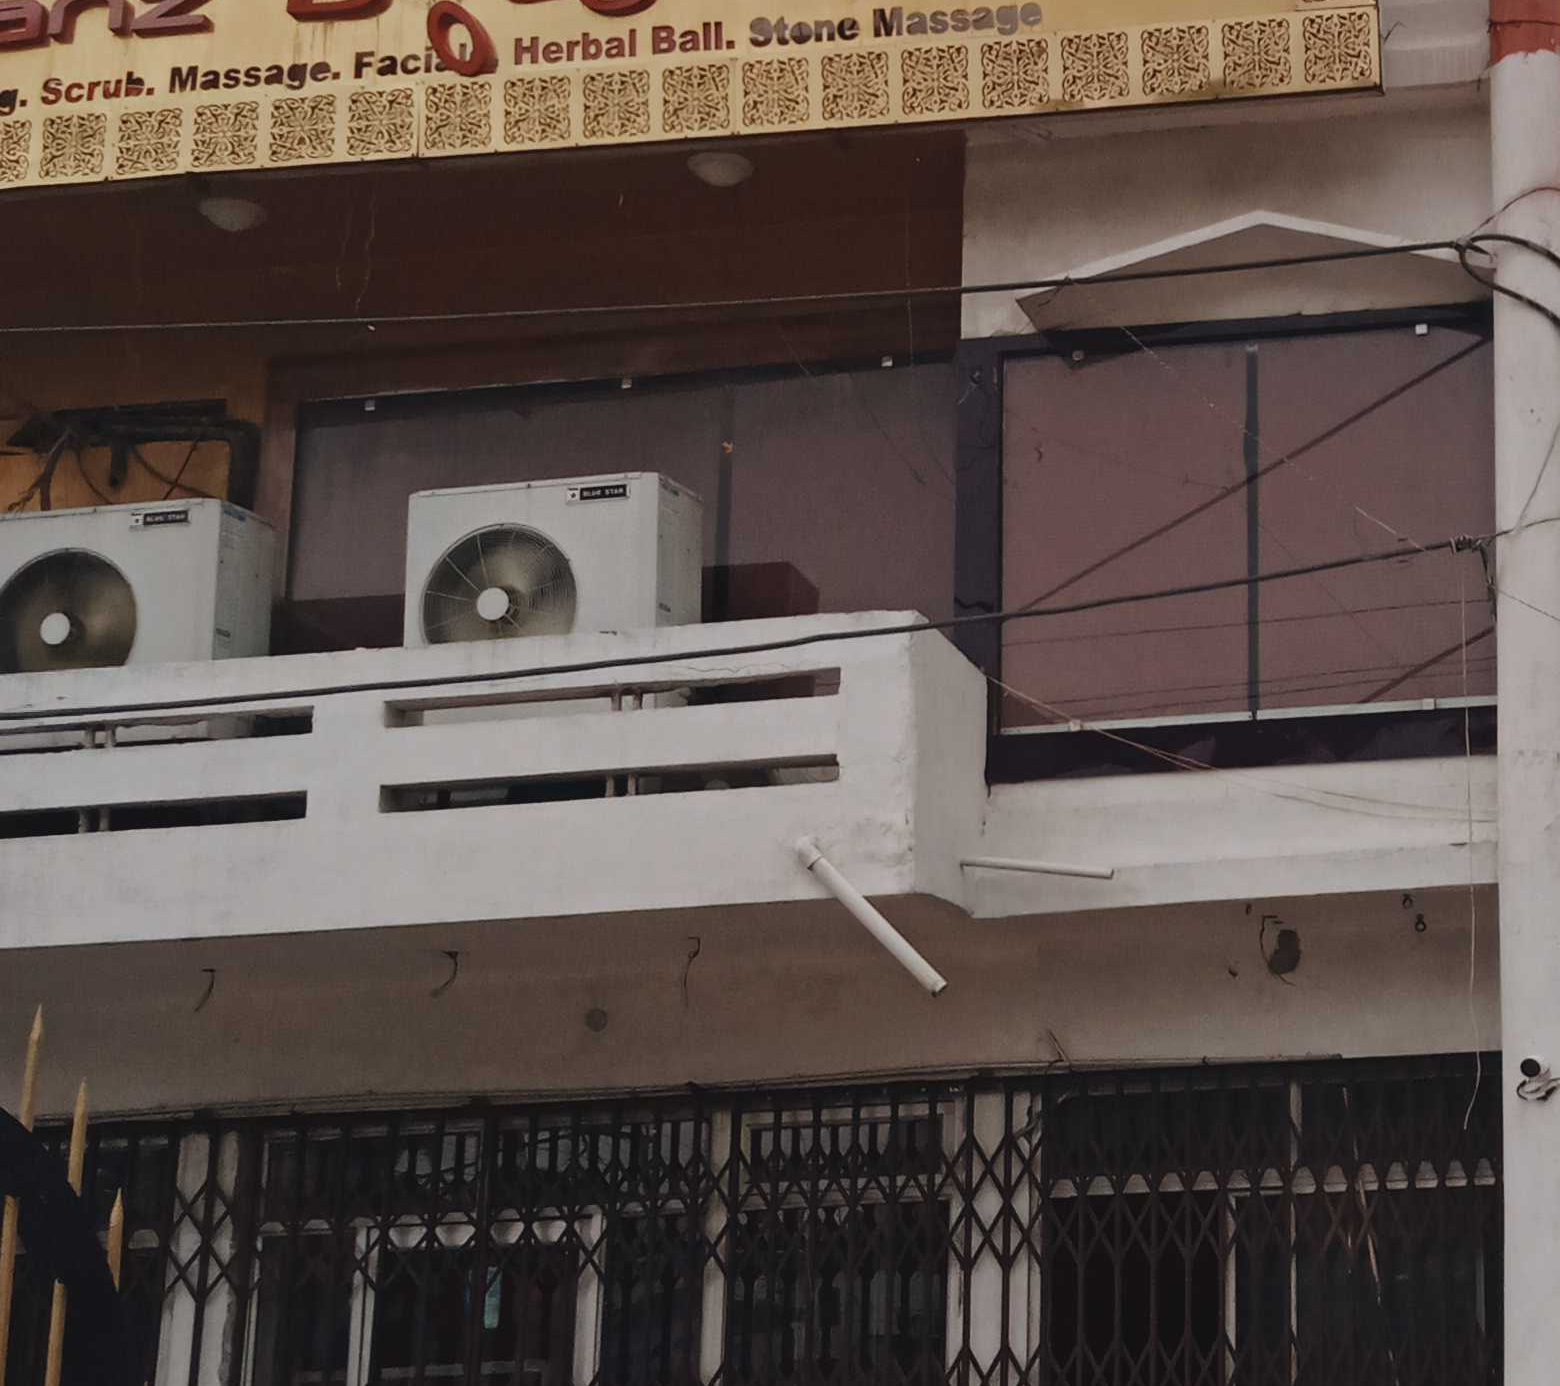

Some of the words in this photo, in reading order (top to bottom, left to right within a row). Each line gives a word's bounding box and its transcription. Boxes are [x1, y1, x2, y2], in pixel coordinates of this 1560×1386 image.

[41, 71, 155, 105] Scrub.
[168, 60, 342, 93] Massage.
[513, 27, 637, 65] Herbal
[652, 19, 735, 56] Ball.
[749, 15, 859, 46] Stone
